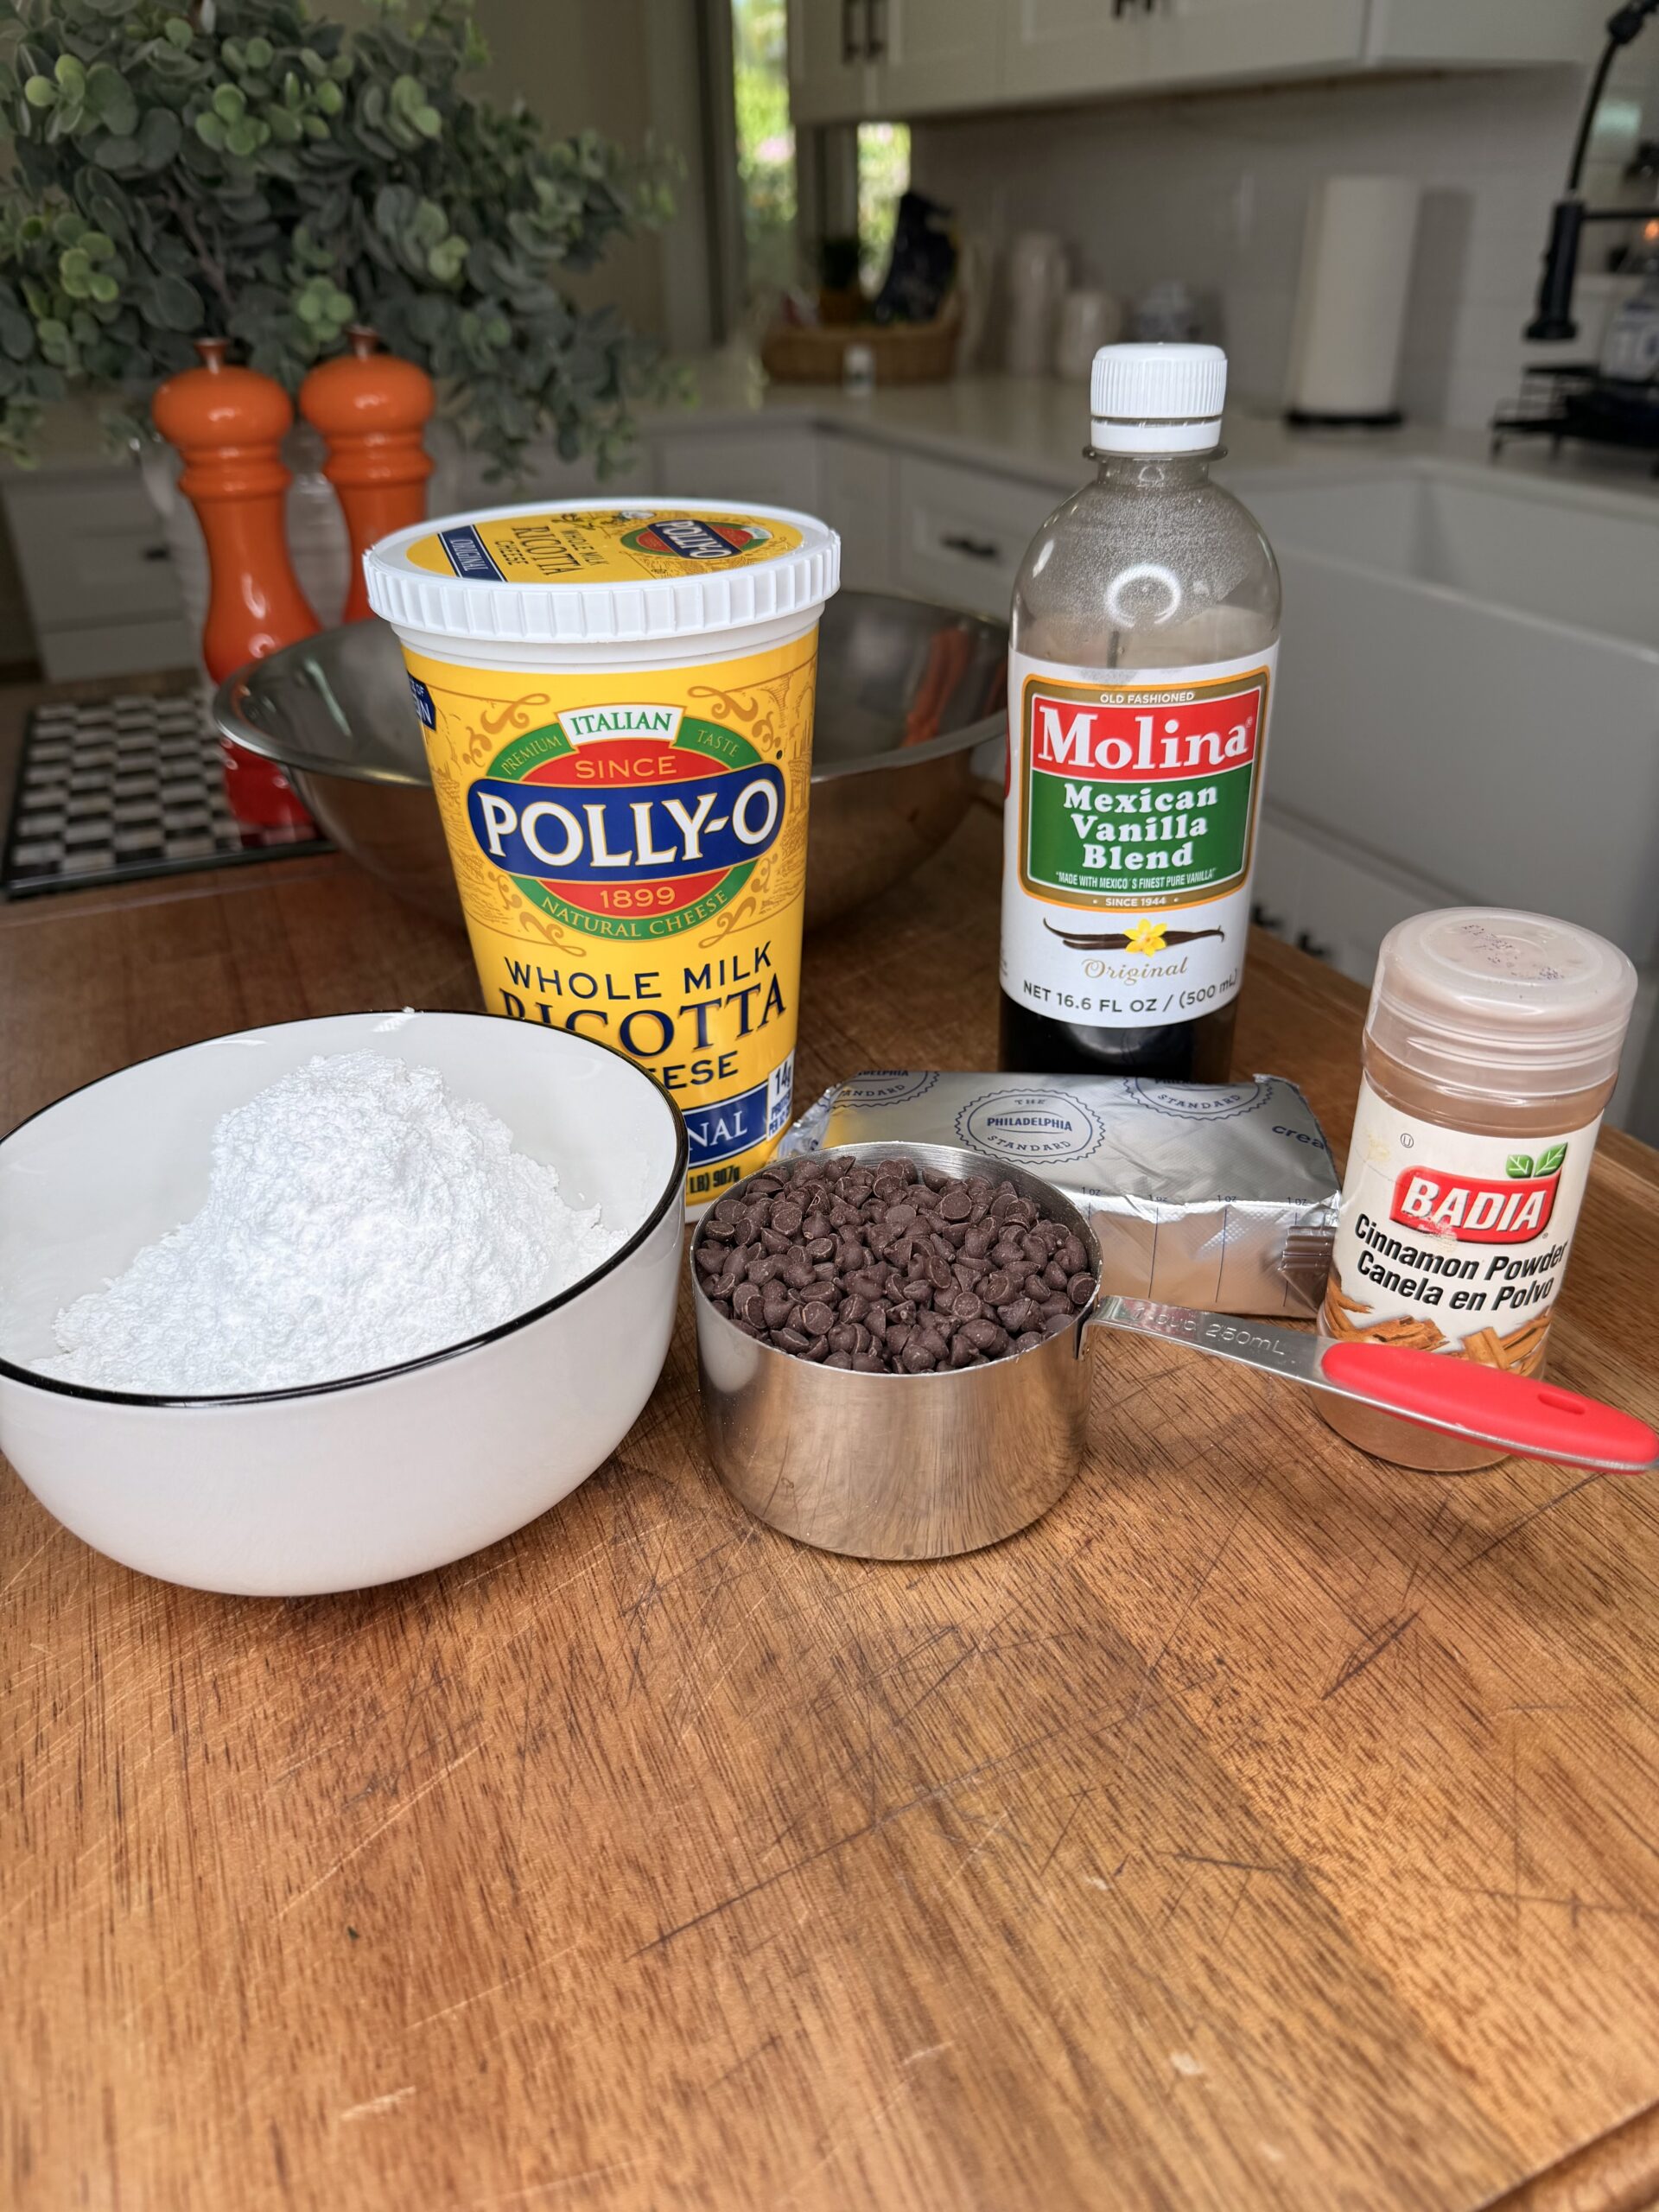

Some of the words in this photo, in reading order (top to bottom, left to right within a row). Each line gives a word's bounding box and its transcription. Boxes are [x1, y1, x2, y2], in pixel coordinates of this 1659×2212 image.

[495, 540, 529, 566] CHEESE
[512, 525, 585, 575] RICOTTA
[563, 530, 594, 551] WHOLE
[655, 520, 733, 558] POLLY-O
[449, 538, 489, 572] ORIGINAL
[1100, 694, 1123, 704] OLD
[1128, 692, 1194, 704] FASHIONED
[570, 712, 673, 735] ITALIAN
[1038, 706, 1249, 770] Molina
[500, 735, 561, 775] PREMIUM
[696, 729, 741, 759] TASTE
[575, 755, 677, 779] SINCE
[1064, 783, 1217, 813] Mexican
[478, 779, 778, 867] POLLY-O
[1071, 813, 1208, 842] Vanilla
[1082, 841, 1193, 871] Blend
[1079, 874, 1097, 888] WITH
[1139, 875, 1164, 889] FINEST
[1166, 874, 1185, 887] PURE
[600, 886, 677, 909] 1899
[1105, 897, 1138, 907] SINCE
[1141, 896, 1166, 906] 1944
[542, 896, 641, 938] NATURAL
[649, 890, 728, 936] CHEESE
[505, 956, 663, 1001] WHOLE
[683, 940, 772, 995] MILK
[1081, 957, 1189, 987] Original
[1023, 979, 1052, 1002] NET
[1056, 992, 1092, 1011] 16.6
[1098, 999, 1123, 1013] FL
[1129, 998, 1158, 1013] OZ
[1178, 986, 1216, 1009] (500
[646, 1051, 739, 1090] ESE
[1158, 1094, 1241, 1109] STANDARD
[987, 1117, 1072, 1132] PHILADELPHIA
[987, 1135, 1071, 1152] STANDARD
[1401, 1176, 1547, 1232] BADIA
[1354, 1213, 1478, 1281] Cinnamon
[1484, 1239, 1568, 1281] Powder
[1357, 1249, 1444, 1306] Canela
[1448, 1291, 1486, 1312] en
[1491, 1276, 1554, 1312] Polvo
